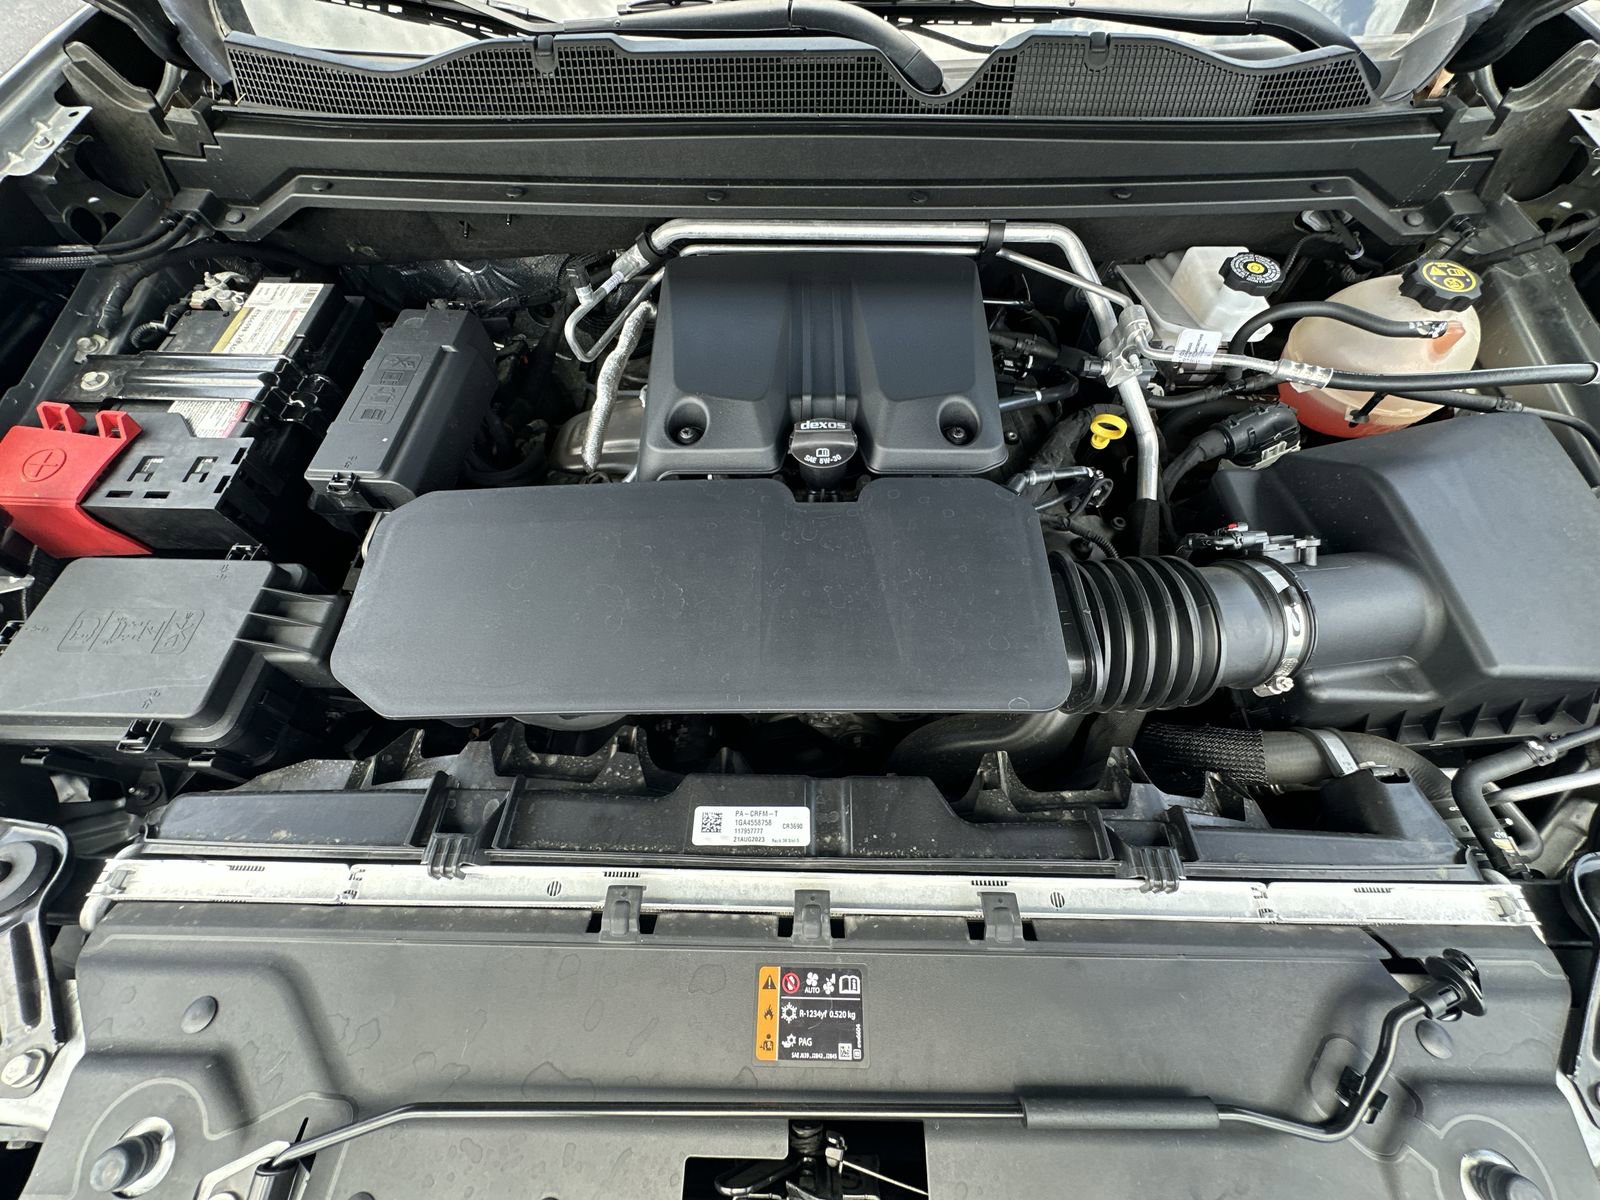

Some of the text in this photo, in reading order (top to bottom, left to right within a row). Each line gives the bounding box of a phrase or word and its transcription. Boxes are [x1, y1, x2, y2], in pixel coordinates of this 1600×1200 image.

[800, 420, 847, 430] dexos
[803, 453, 842, 465] SAE 5W-30
[804, 986, 820, 994] AUTO
[799, 1010, 856, 1021] R-1234yf 0.520 kg
[798, 1037, 813, 1047] PAG
